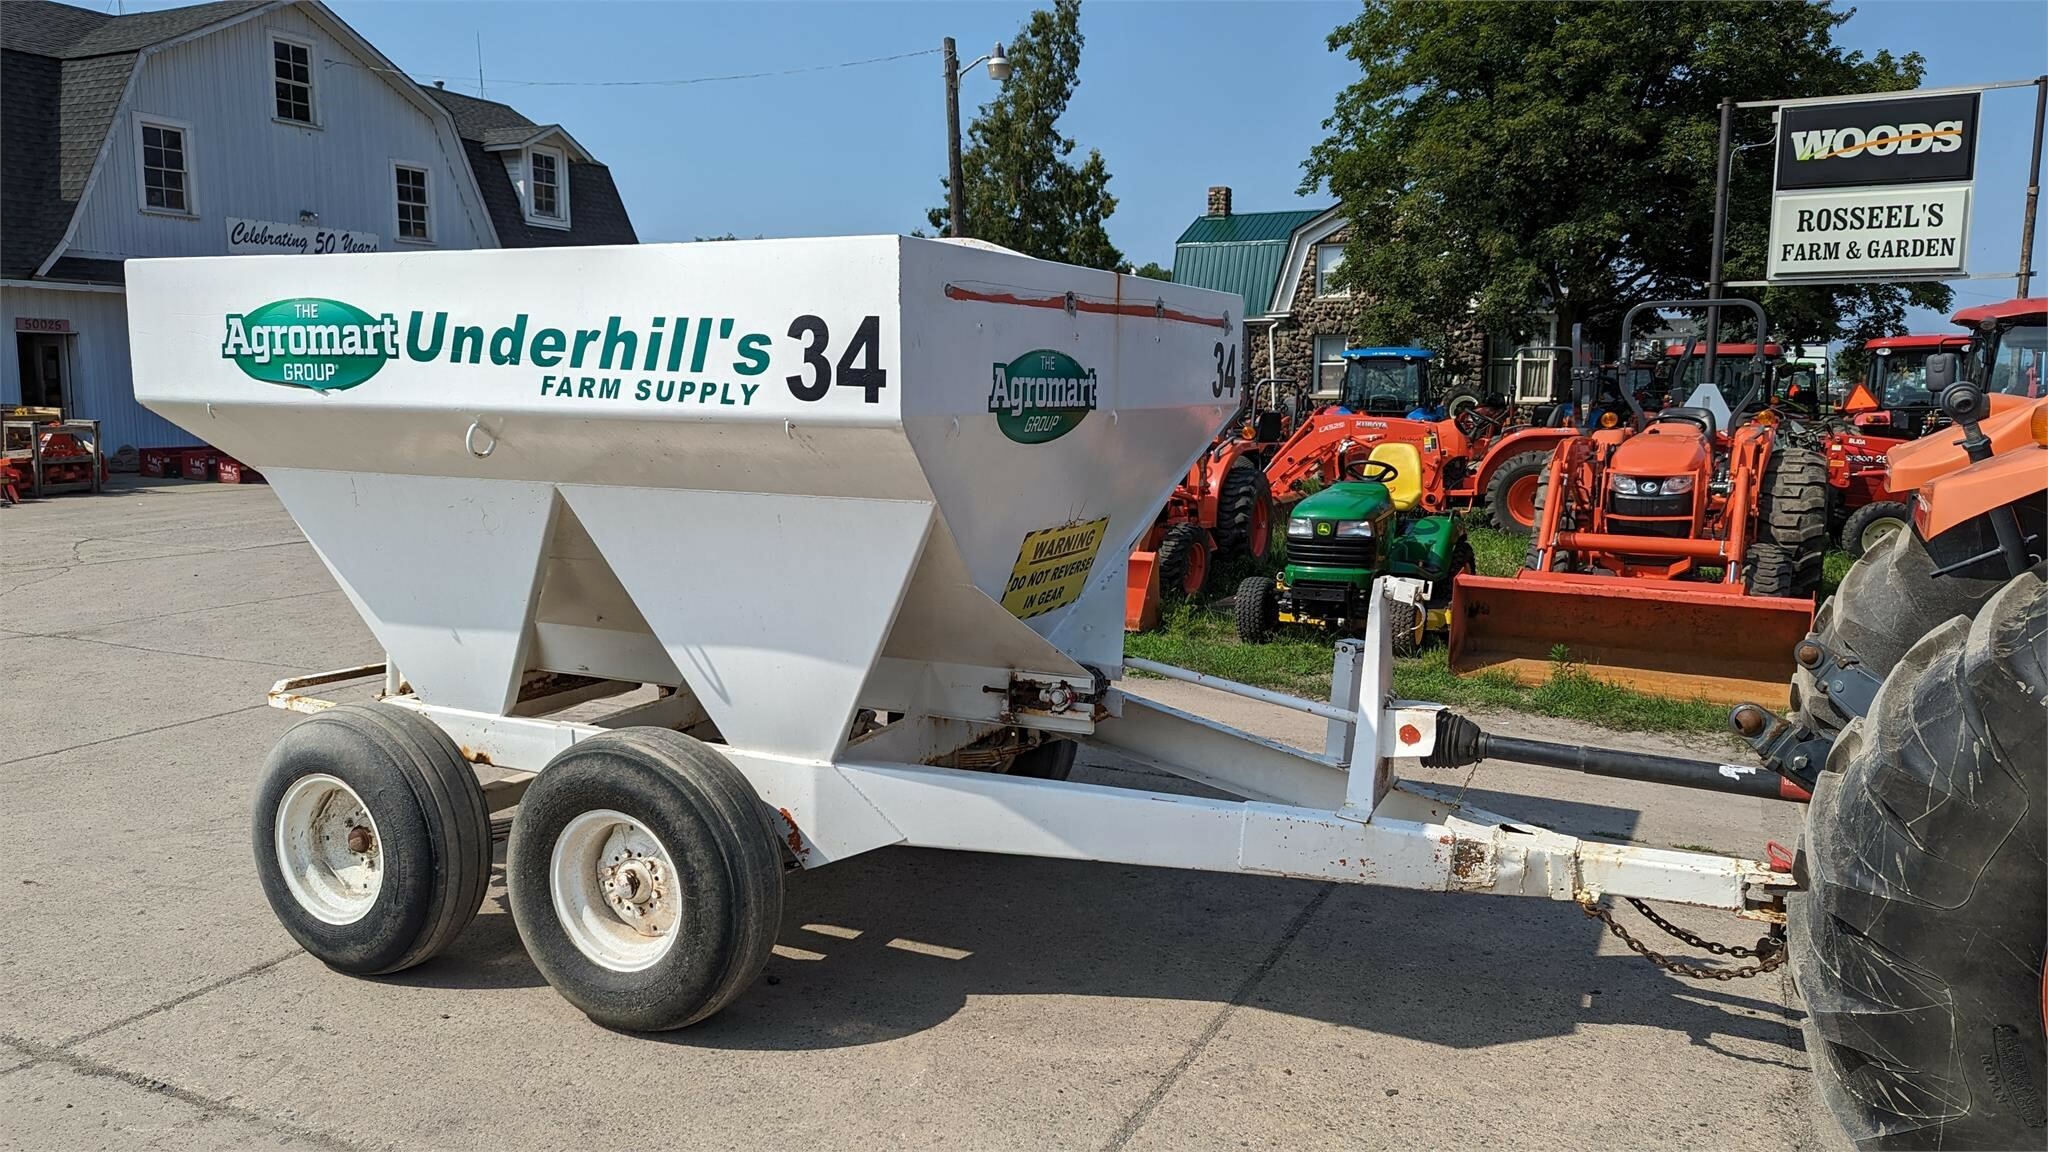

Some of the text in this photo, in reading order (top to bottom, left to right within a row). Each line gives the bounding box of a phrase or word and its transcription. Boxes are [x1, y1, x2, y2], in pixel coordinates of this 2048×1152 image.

[1791, 120, 1964, 161] WOODS
[1796, 203, 1944, 232] ROSSEEL'S
[231, 221, 378, 255] Celebrating 50 Years
[1781, 237, 1956, 262] FARM & GARDEN
[24, 318, 62, 331] 50025
[294, 303, 319, 319] THE
[224, 317, 398, 364] Agromart
[405, 310, 773, 377] Underhill's
[283, 363, 336, 381] GROUP
[786, 314, 887, 405] 34
[1040, 355, 1056, 371] THE
[1212, 341, 1236, 398] 34
[540, 375, 761, 406] FARM SUPPLY
[990, 366, 1096, 416] Agromart
[1023, 415, 1060, 433] GROUP
[190, 457, 205, 470] LMC
[219, 462, 238, 475] LMC
[1032, 528, 1096, 560] WARNING
[1009, 575, 1027, 593] DO
[1027, 568, 1052, 586] NOT
[1022, 586, 1065, 610] IN GEAR
